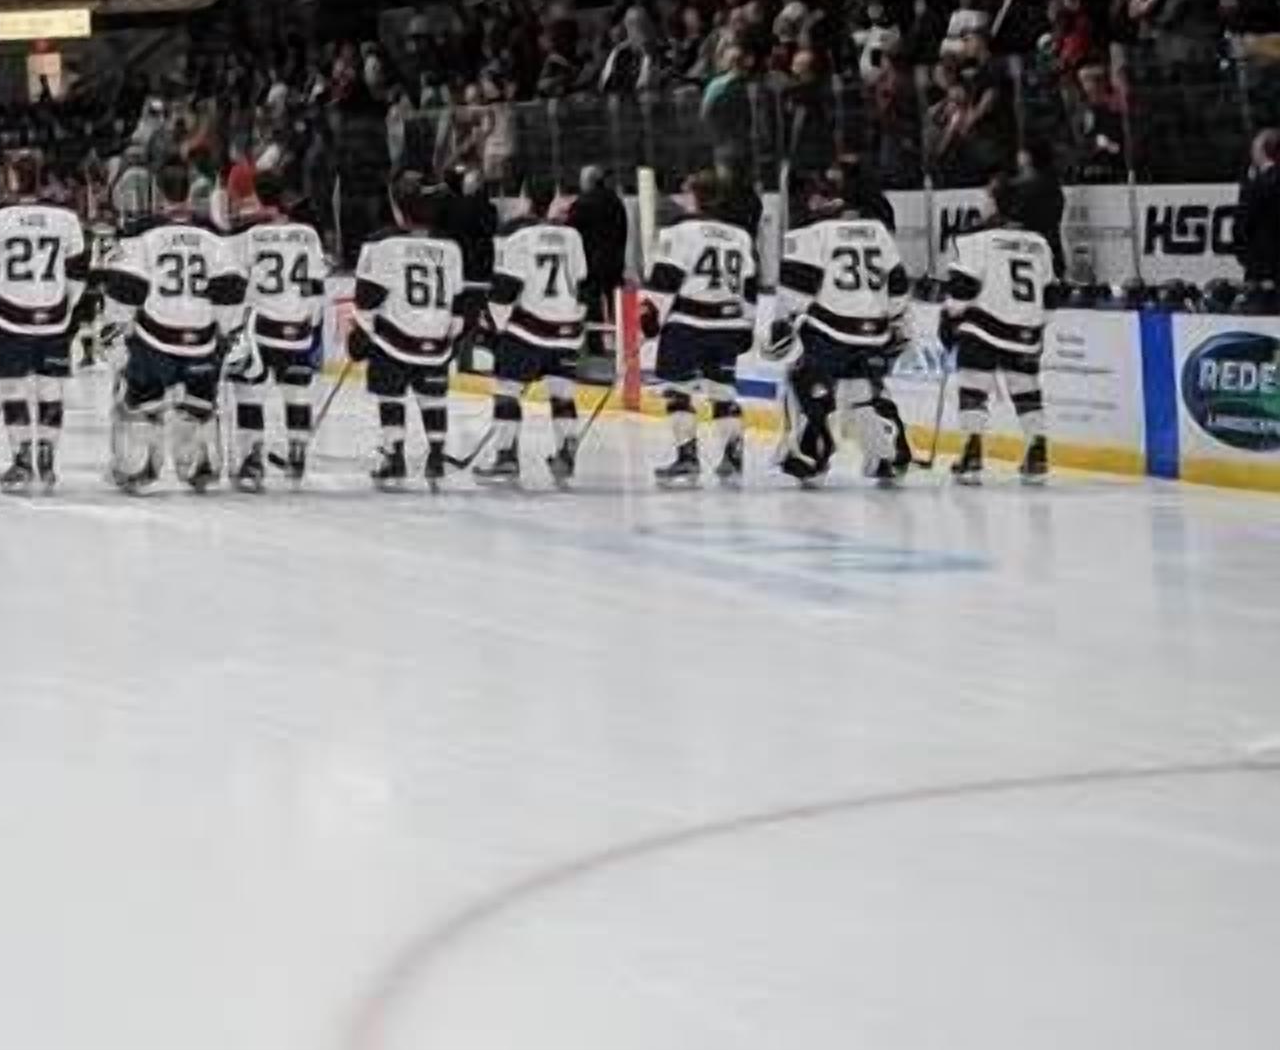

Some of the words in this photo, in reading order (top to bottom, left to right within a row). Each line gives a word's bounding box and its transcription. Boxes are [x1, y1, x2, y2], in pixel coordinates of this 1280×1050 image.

[5, 237, 60, 281] 27
[254, 251, 313, 297] 34
[832, 247, 890, 291] 35
[1010, 259, 1037, 302] 5
[405, 264, 445, 309] 61
